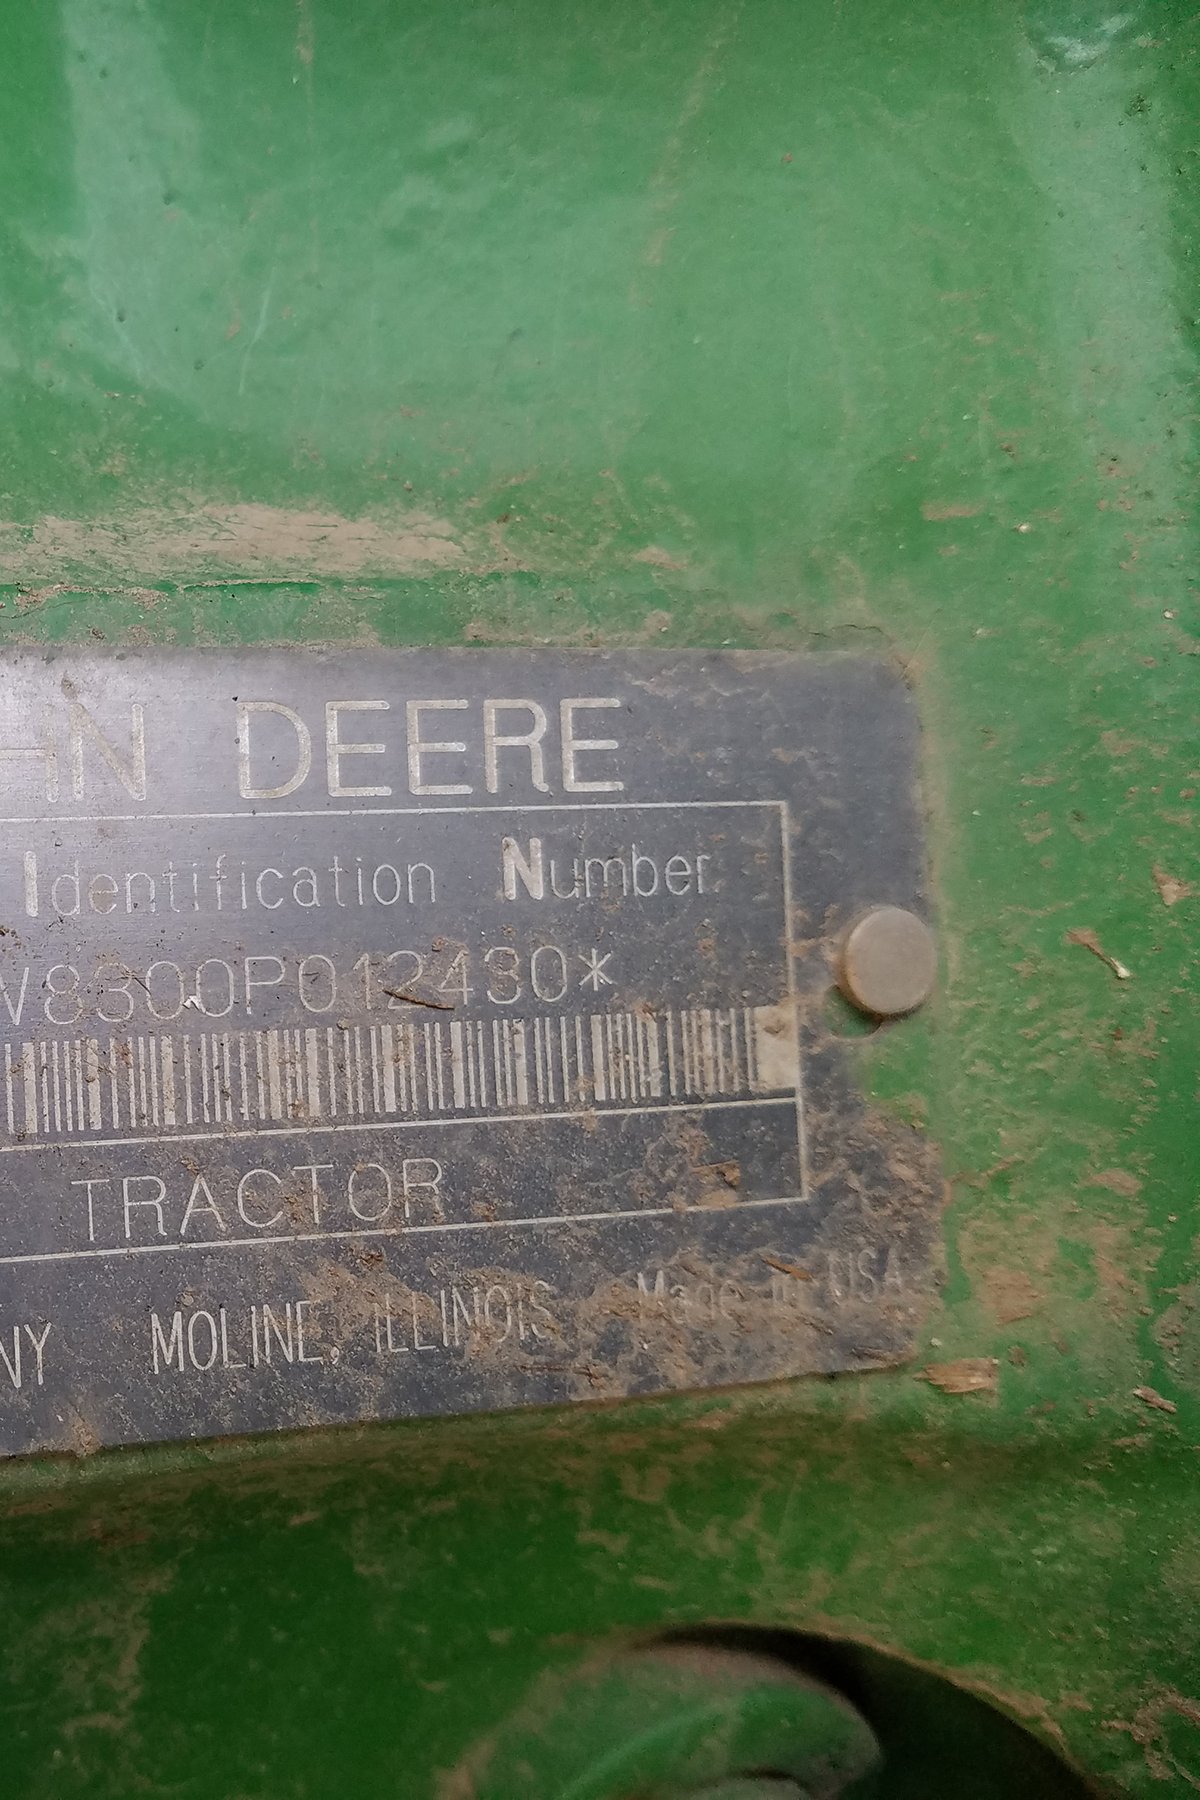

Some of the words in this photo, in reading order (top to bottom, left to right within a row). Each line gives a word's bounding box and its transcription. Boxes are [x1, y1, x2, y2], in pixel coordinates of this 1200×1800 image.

[236, 696, 624, 799] DEERE
[24, 850, 436, 917] Identification
[501, 836, 711, 900] Number
[71, 1156, 444, 1241] TRACTOR
[373, 1279, 557, 1354] ILLINOIS
